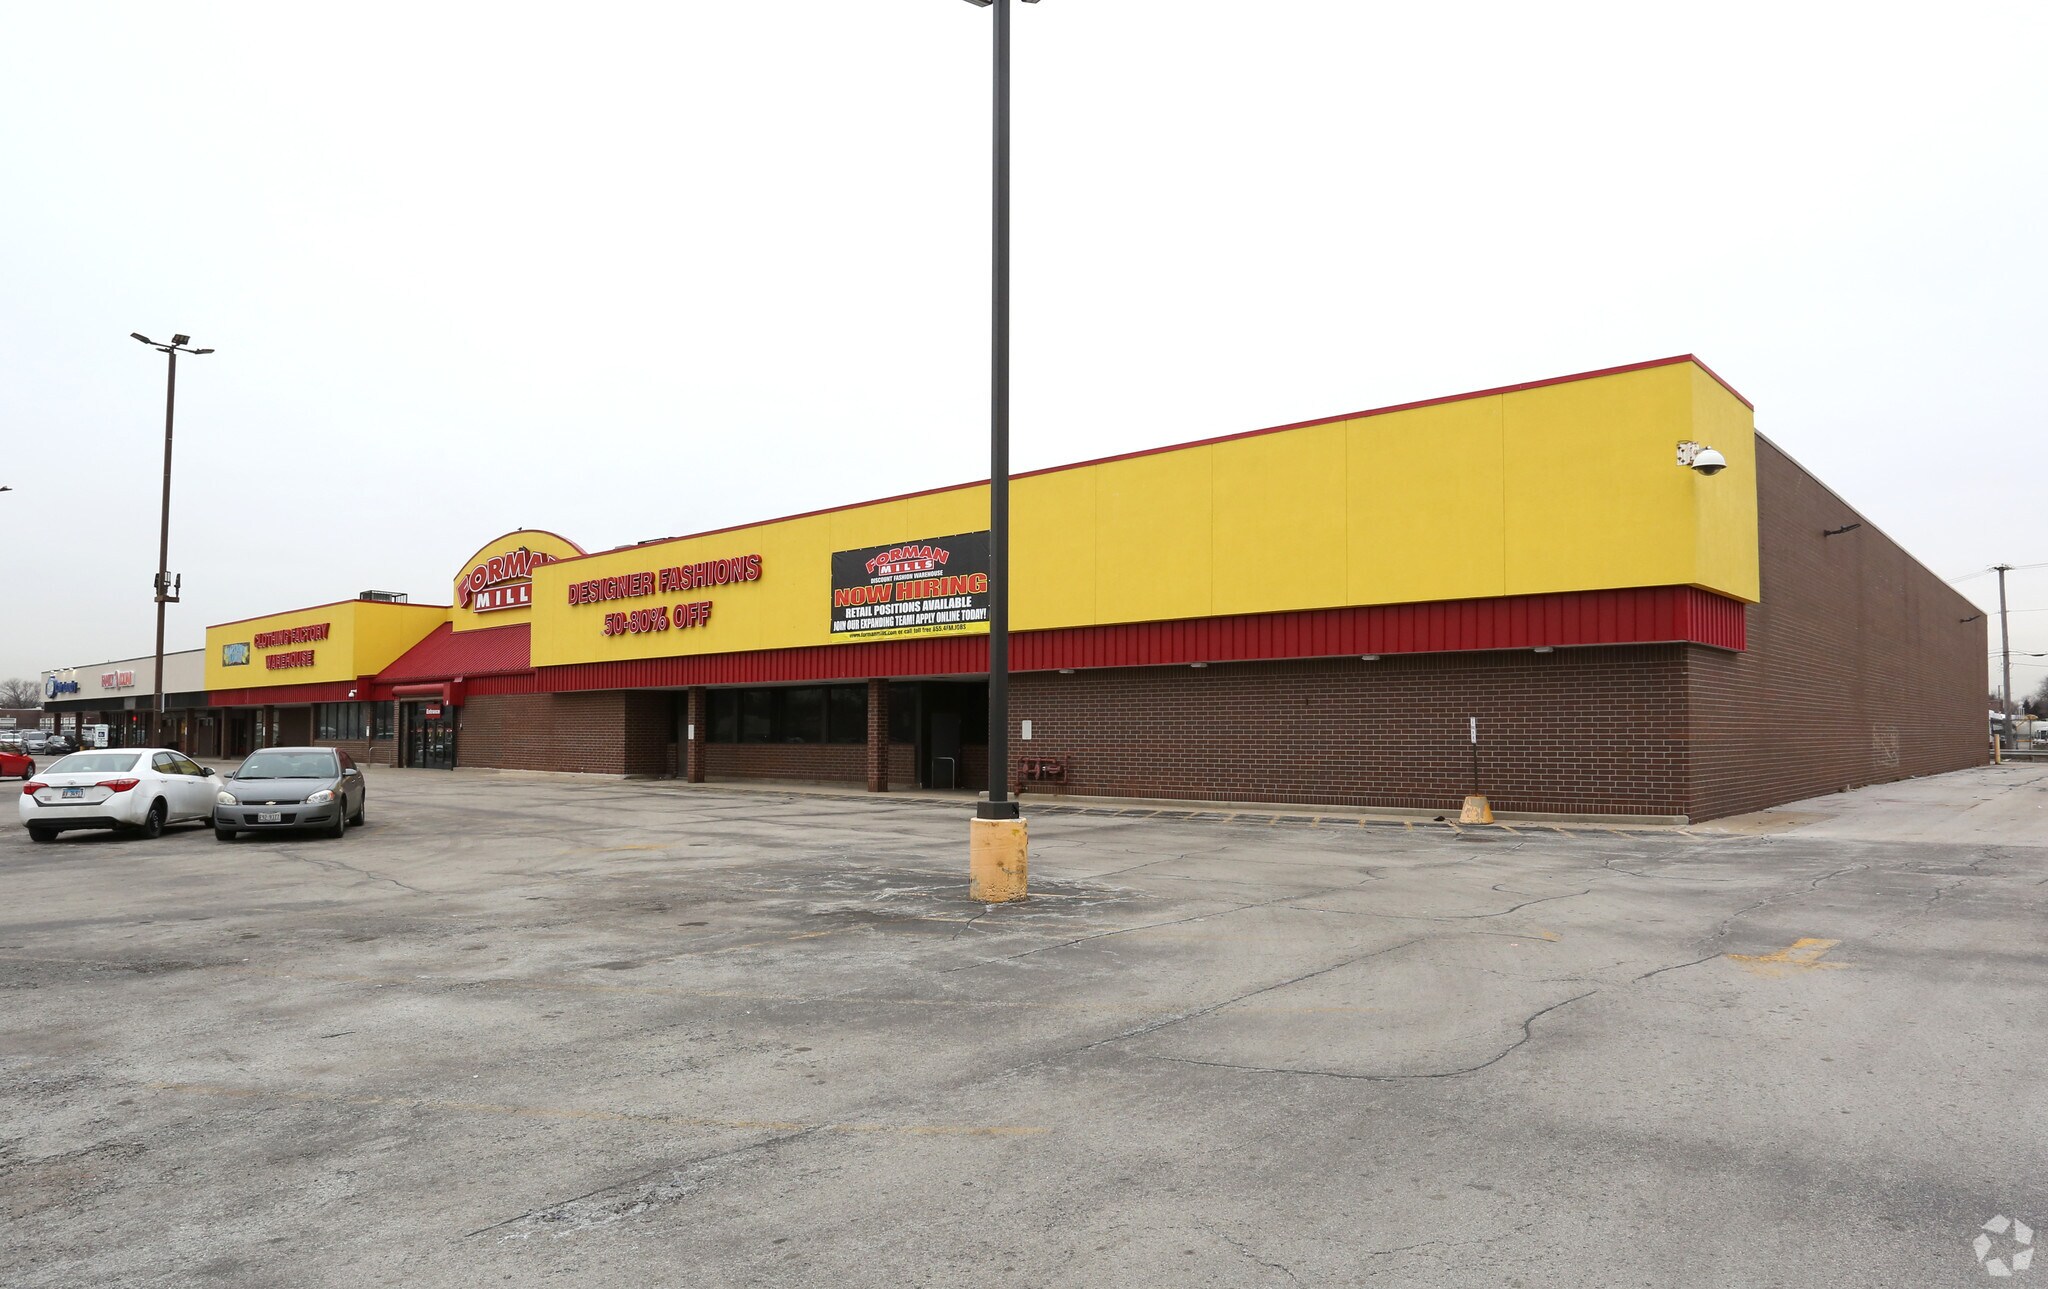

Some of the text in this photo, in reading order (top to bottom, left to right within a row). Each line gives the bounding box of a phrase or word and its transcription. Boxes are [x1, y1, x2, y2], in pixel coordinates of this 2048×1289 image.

[865, 544, 949, 574] FORMAN
[880, 559, 933, 574] MILLS
[568, 554, 762, 606] DESIGNER FASHIONS
[834, 572, 988, 607] NOW HIRING
[870, 569, 944, 584] DISCOUNT FASHION WAREHOUSE
[603, 600, 713, 636] 50-80% OFF
[833, 607, 987, 632] JOIN OUR EXPANDING TEAM! APPLY ONLINE TODAY!
[845, 596, 972, 618] RETAIL POSITIONS AVAILABLE
[254, 622, 330, 649] CLOTHING FACTORY
[265, 649, 315, 671] WAREHOUSE
